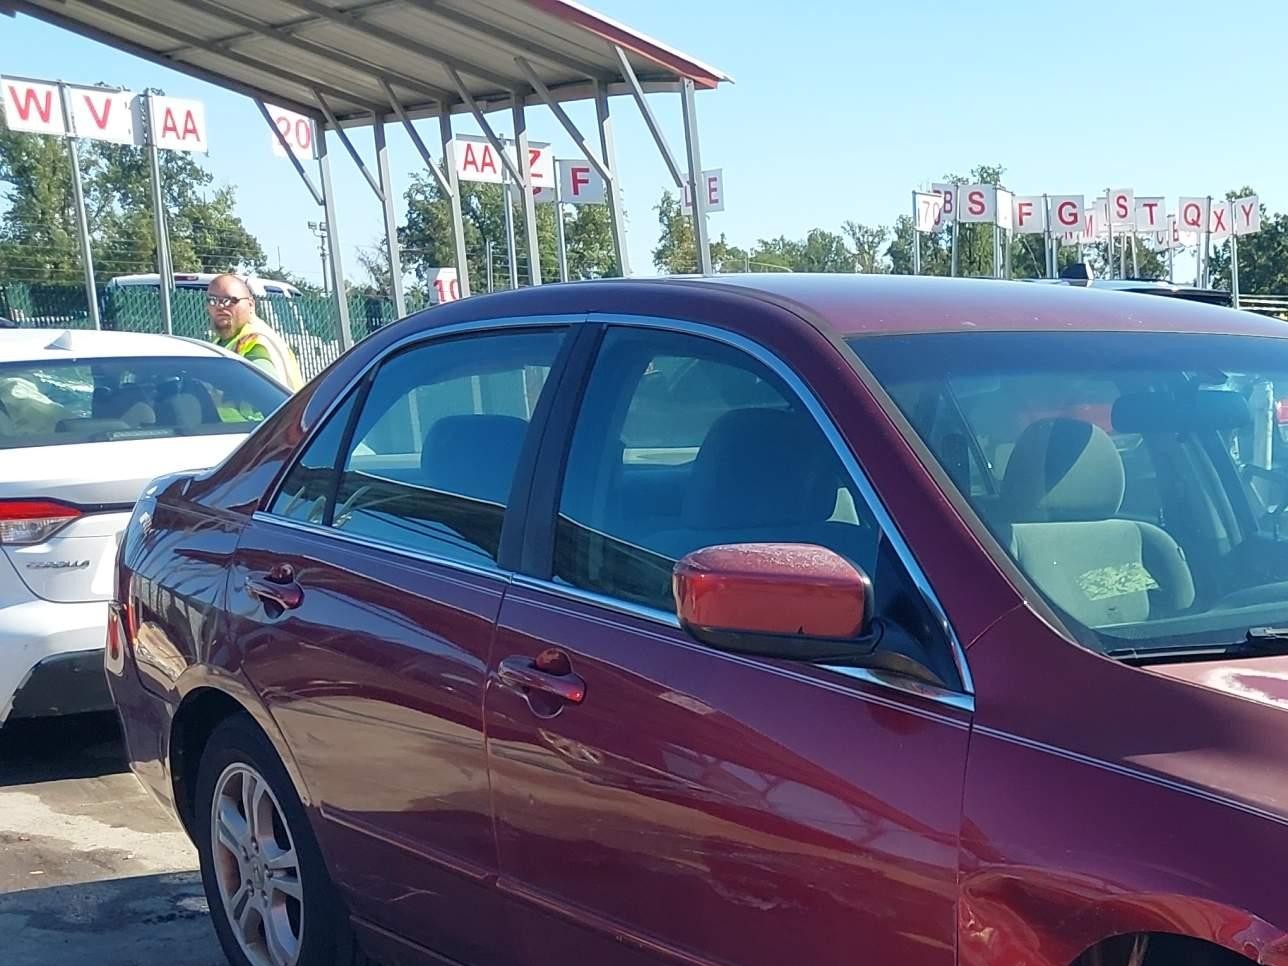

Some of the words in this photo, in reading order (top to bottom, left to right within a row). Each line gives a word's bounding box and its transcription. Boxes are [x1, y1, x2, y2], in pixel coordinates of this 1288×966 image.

[8, 86, 52, 123] W
[83, 95, 112, 130] V
[161, 107, 201, 142] AA
[276, 116, 311, 149] 20
[463, 143, 497, 175] AA
[571, 167, 590, 196] F
[708, 176, 720, 204] E
[968, 191, 986, 215] S
[1018, 202, 1033, 227] F
[1057, 201, 1079, 226] G
[1116, 195, 1128, 219] S
[1142, 203, 1158, 225] T
[1184, 203, 1201, 228] Q
[1240, 203, 1254, 227] Y
[1213, 208, 1227, 233] X
